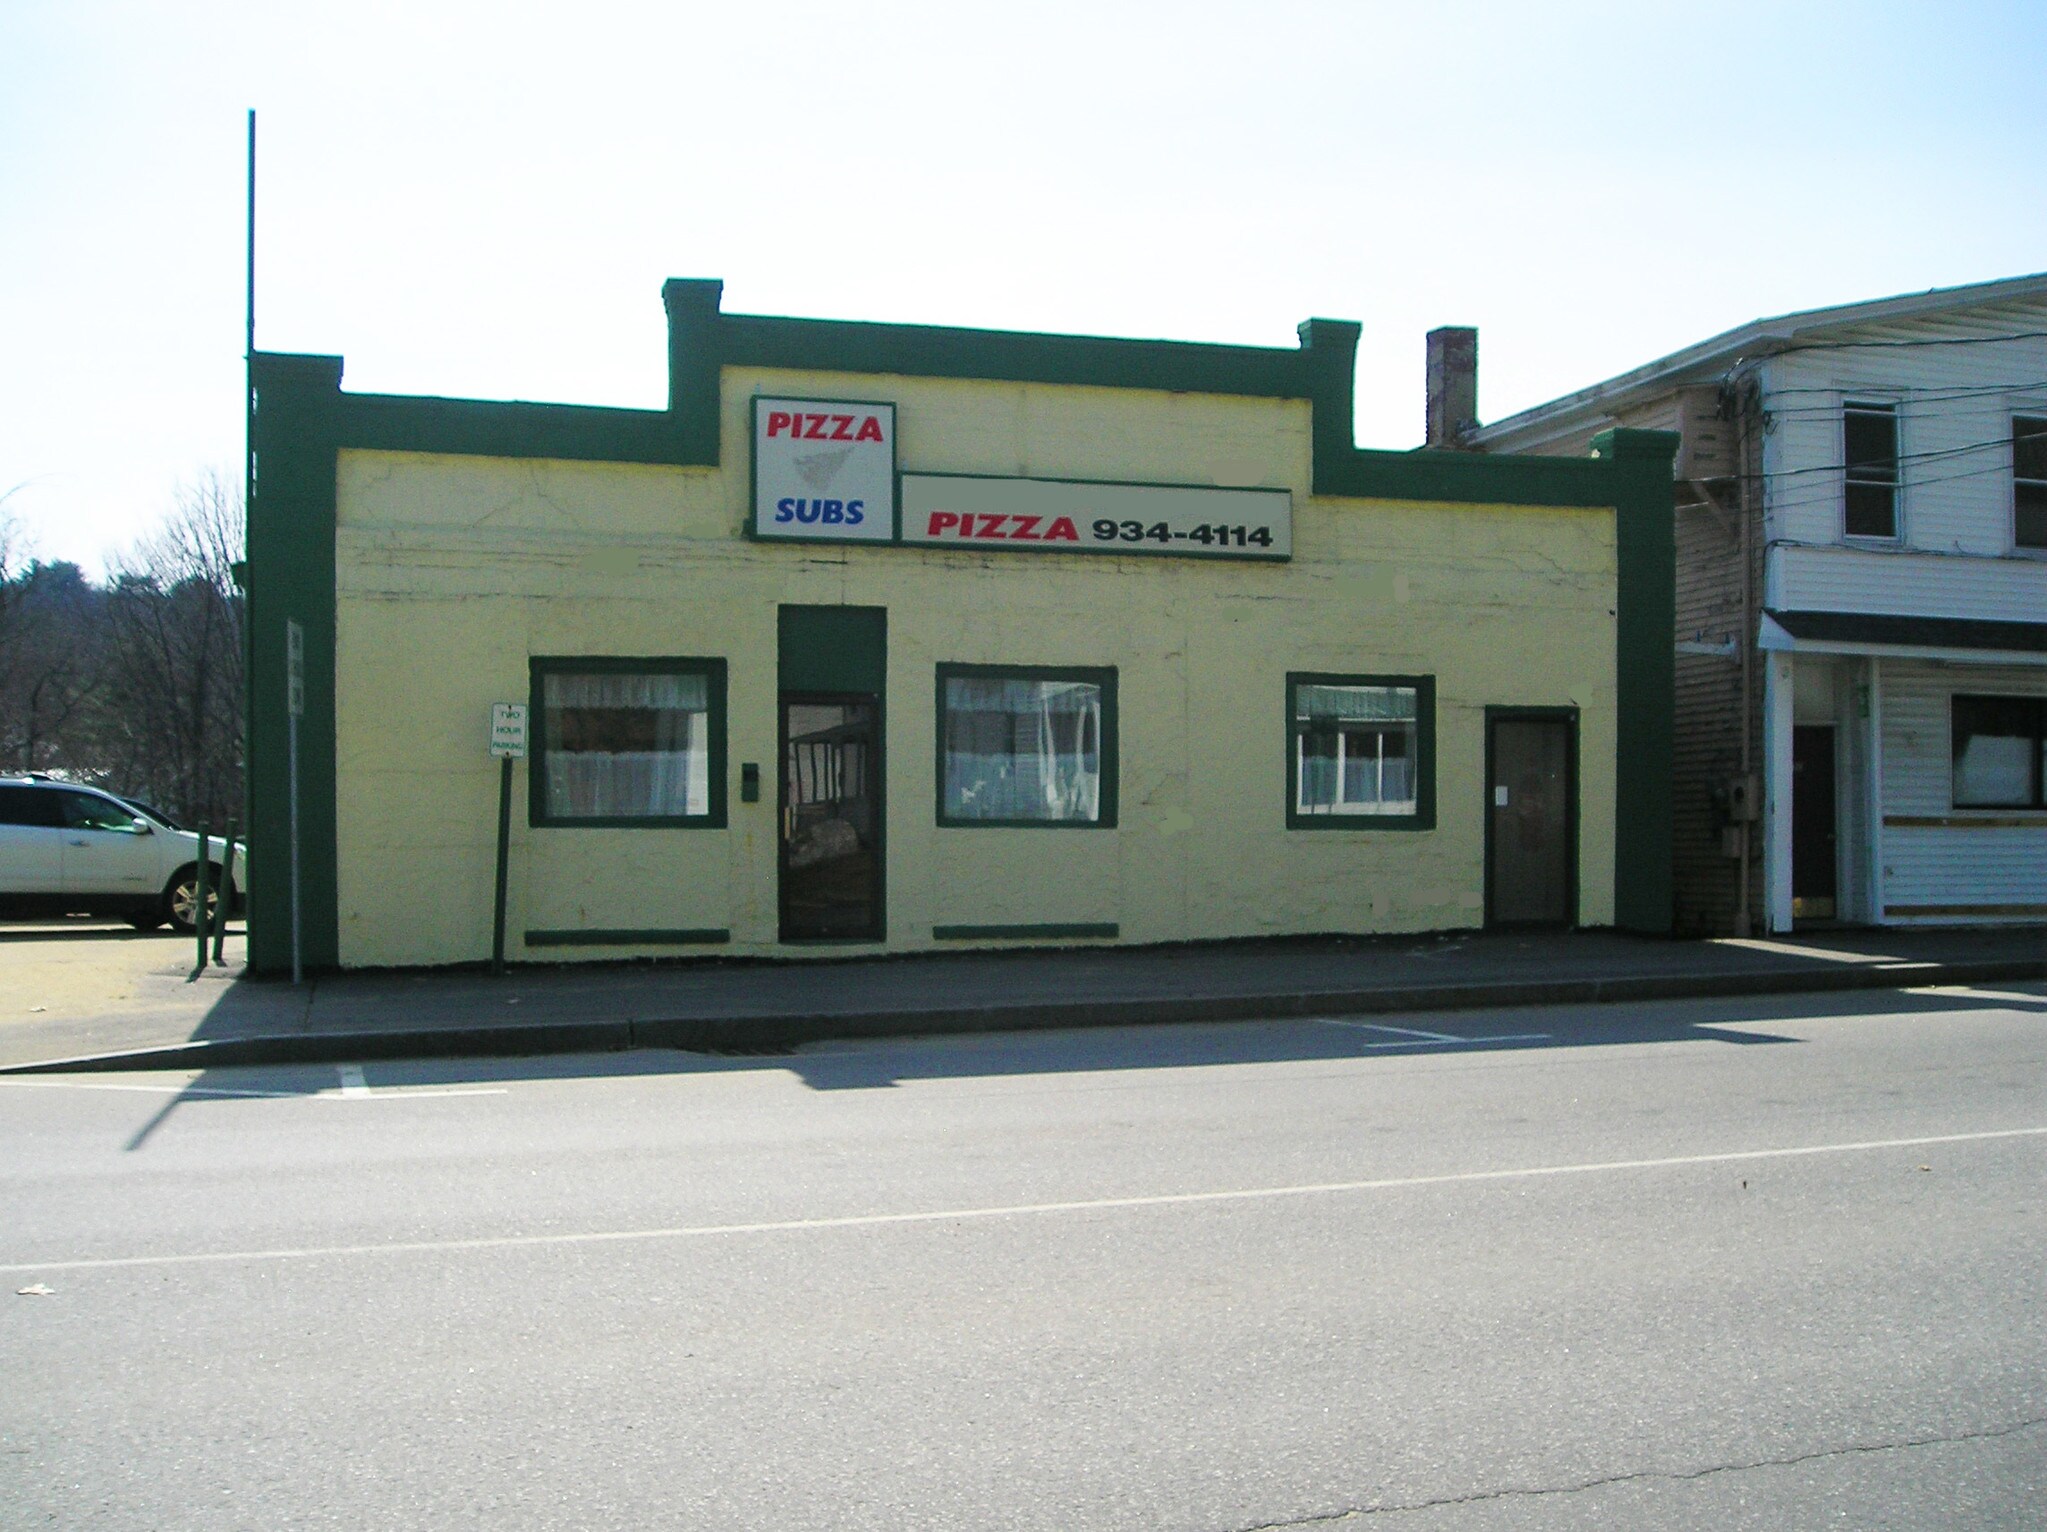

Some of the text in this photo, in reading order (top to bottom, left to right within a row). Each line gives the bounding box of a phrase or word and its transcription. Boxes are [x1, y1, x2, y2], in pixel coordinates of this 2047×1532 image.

[767, 411, 883, 442] PIZZA
[775, 498, 864, 525] SUBS
[928, 511, 1273, 547] PIZZA 934-4114
[502, 711, 520, 719] TWO
[496, 726, 521, 735] HOUR
